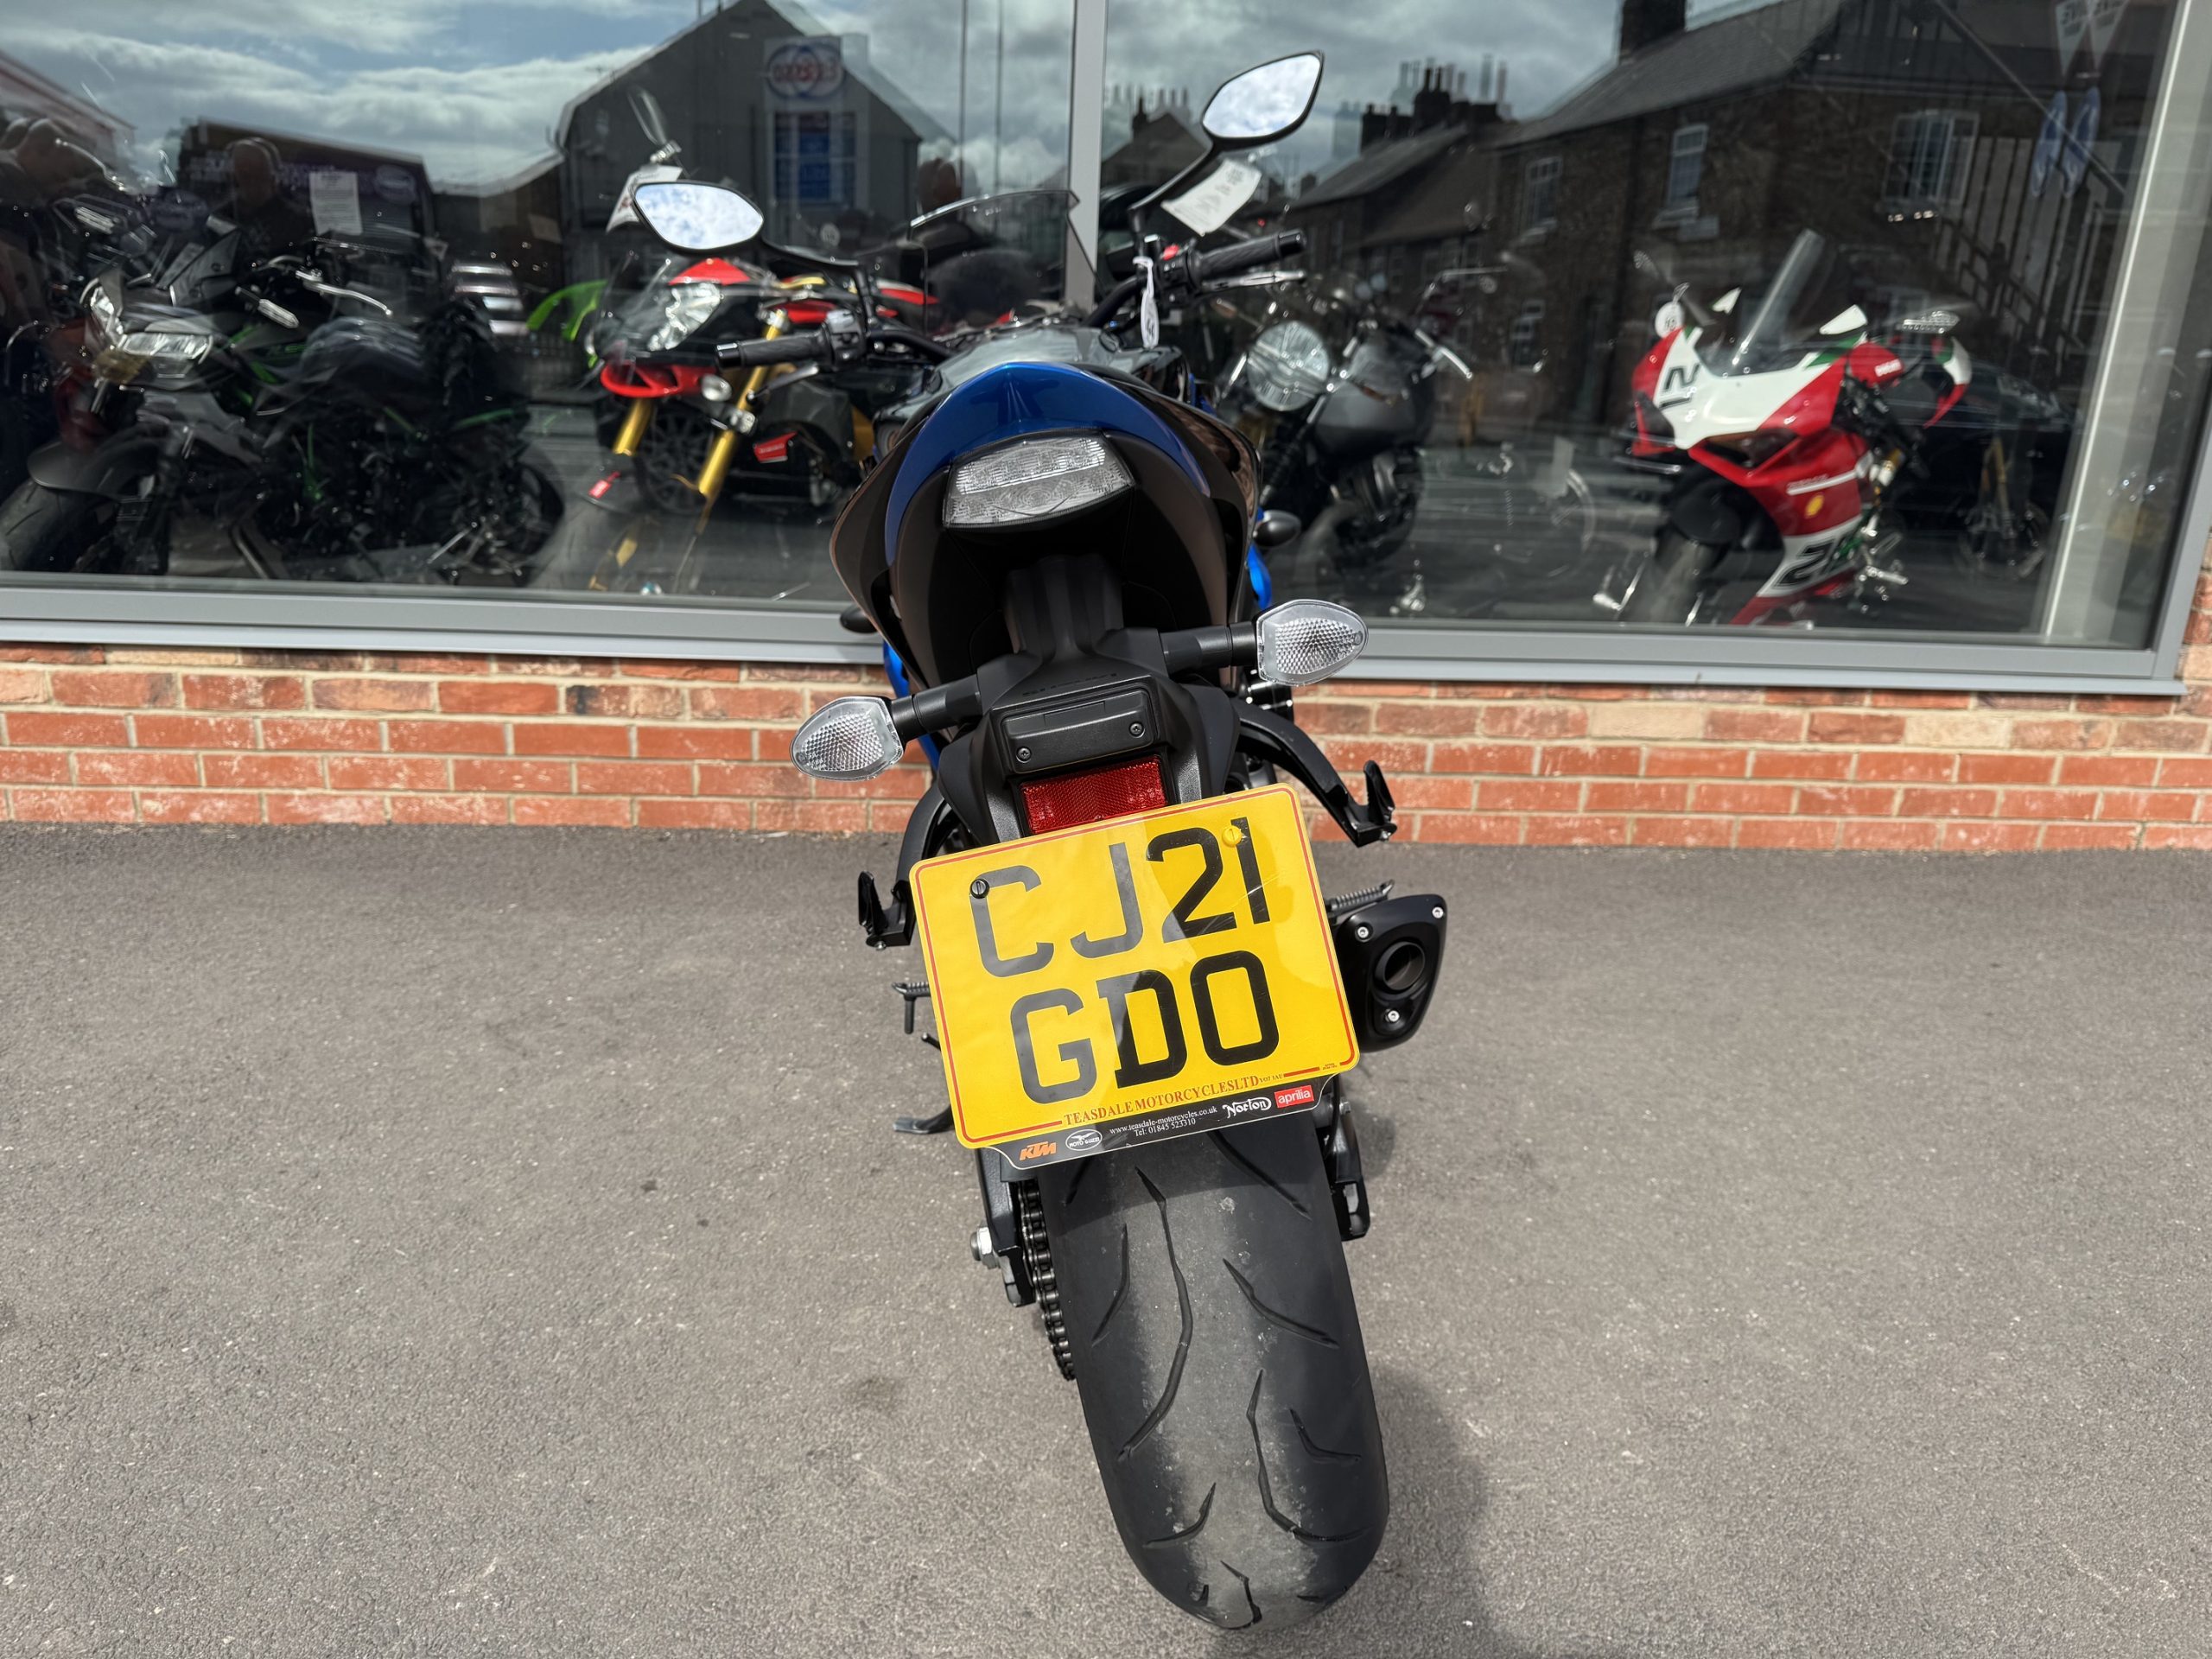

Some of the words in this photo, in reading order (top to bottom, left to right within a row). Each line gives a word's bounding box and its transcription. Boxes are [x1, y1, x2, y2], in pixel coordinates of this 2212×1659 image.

[969, 817, 1270, 977] CJ21
[1010, 950, 1279, 1104] GDO
[1223, 1096, 1272, 1118] Norton
[1278, 1090, 1311, 1104] aprilia
[1064, 1101, 1134, 1126] TEASDALE
[1109, 1105, 1217, 1135] www.teasdale-motorcycles.co.uk
[1134, 1126, 1147, 1137] Tel:
[1147, 1122, 1170, 1135] 01845
[1171, 1118, 1196, 1129] 523310
[1020, 1141, 1056, 1160] KTM
